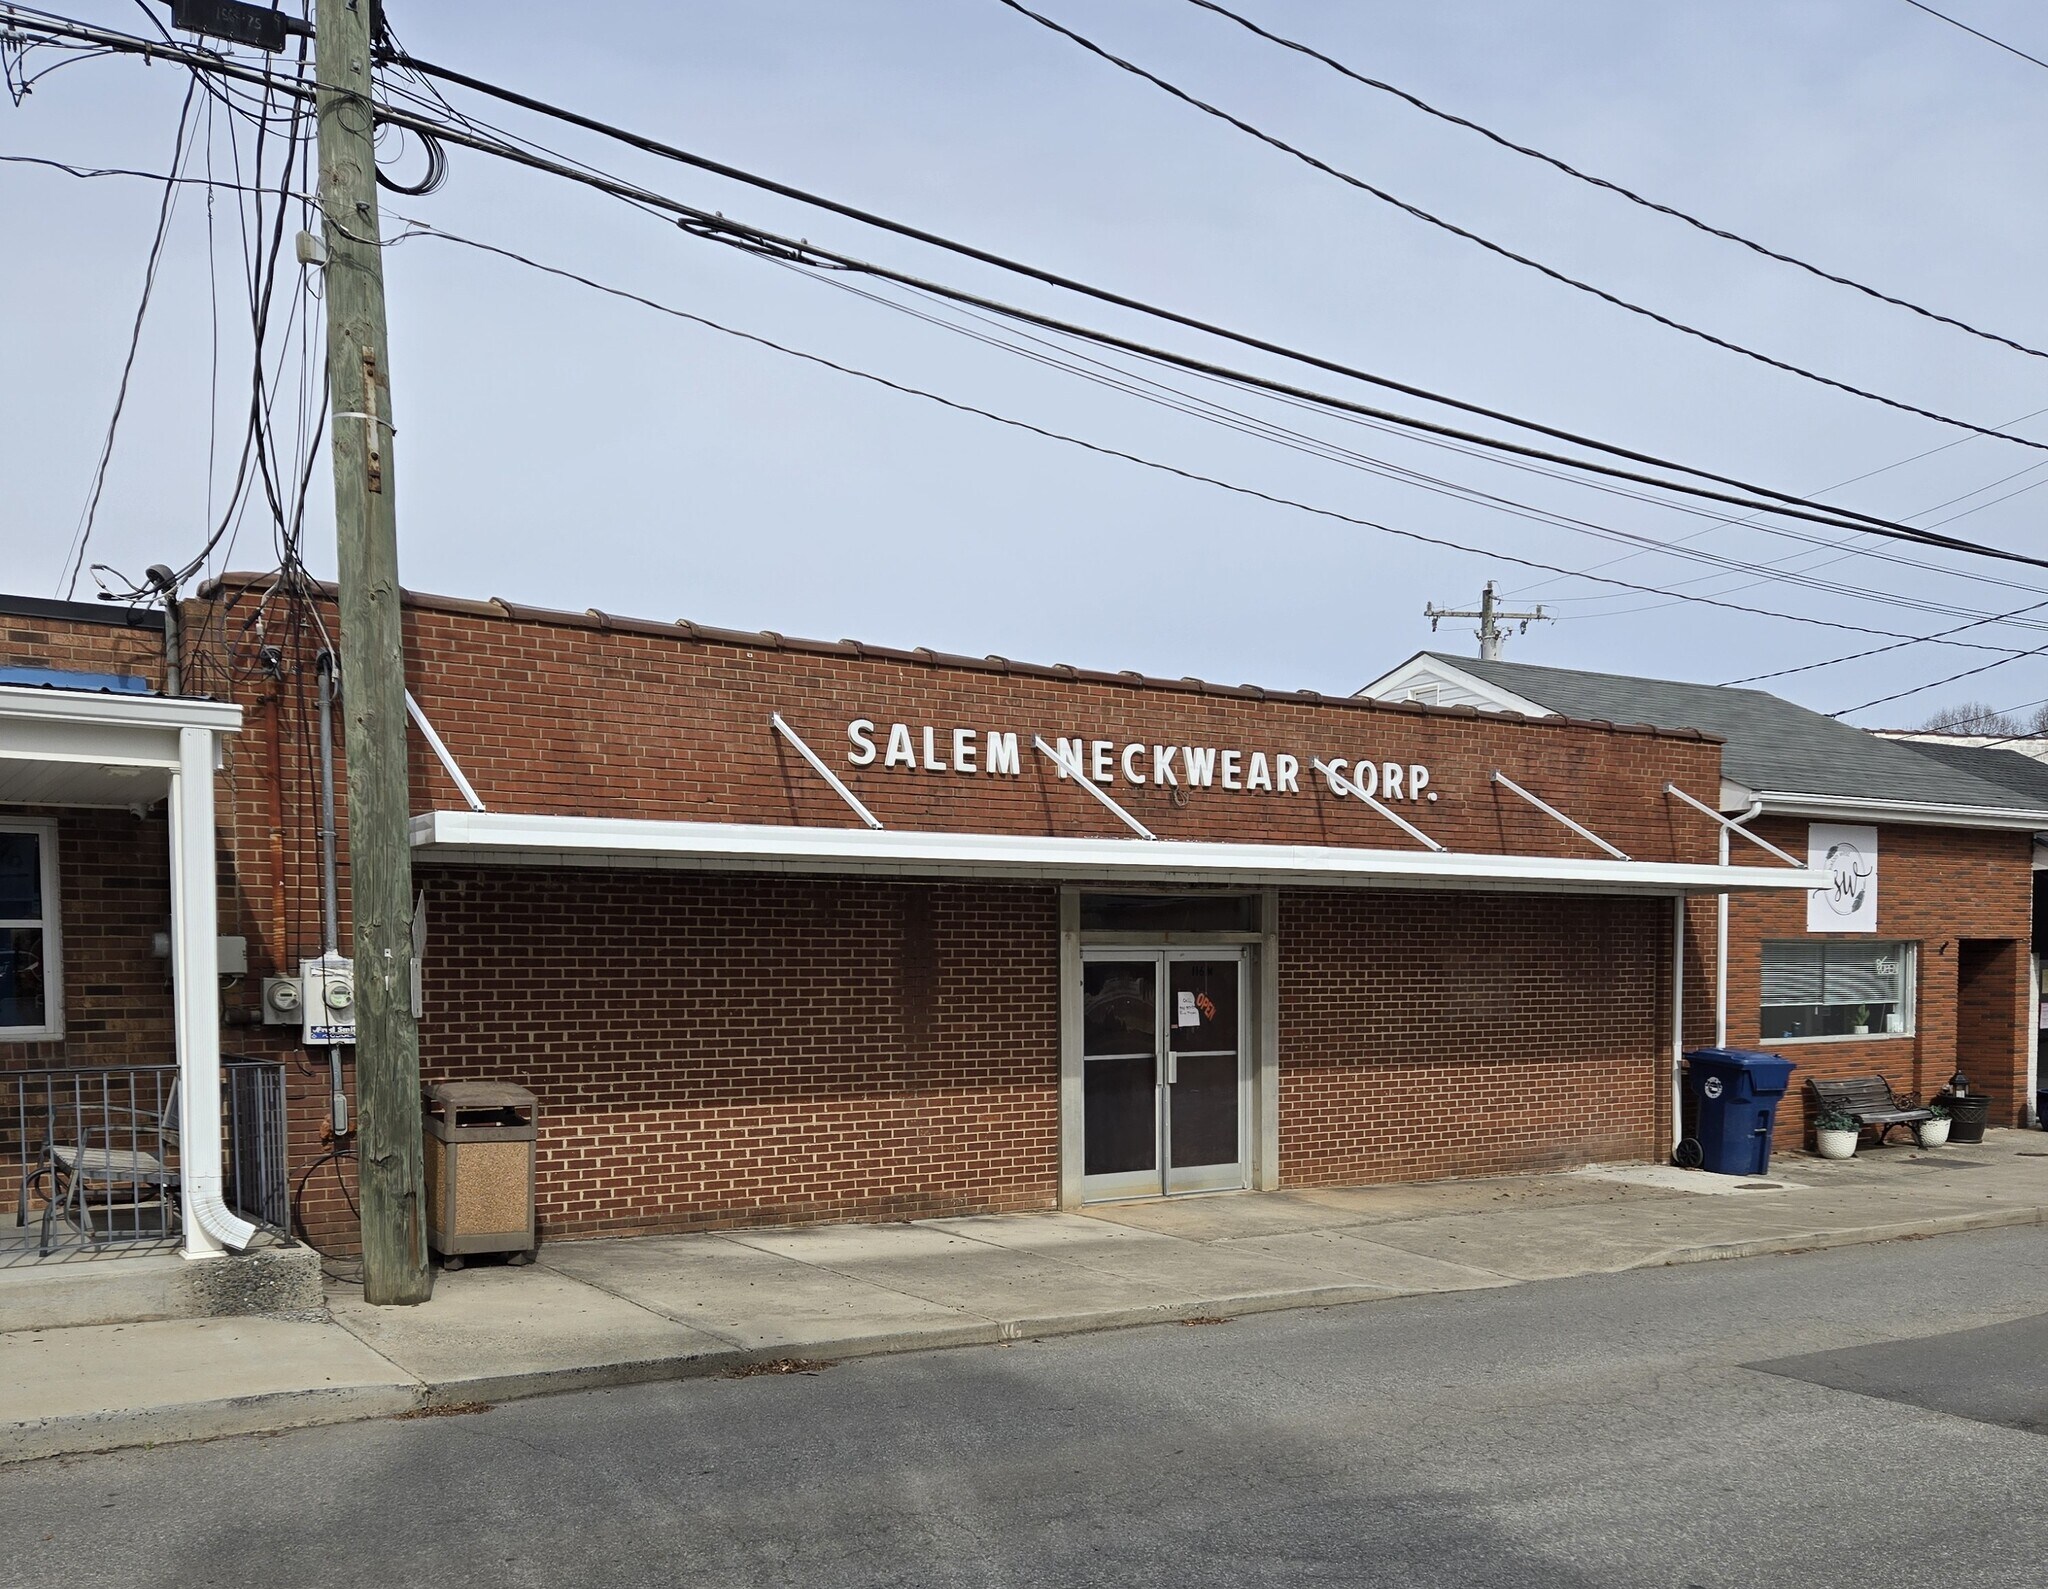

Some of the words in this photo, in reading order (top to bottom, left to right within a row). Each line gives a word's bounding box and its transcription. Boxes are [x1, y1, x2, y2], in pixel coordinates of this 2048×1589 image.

[847, 718, 1020, 775] SALEM
[1056, 736, 1299, 793] NECKWEAR
[1327, 758, 1438, 802] CORP.
[1196, 993, 1216, 1021] OPEN
